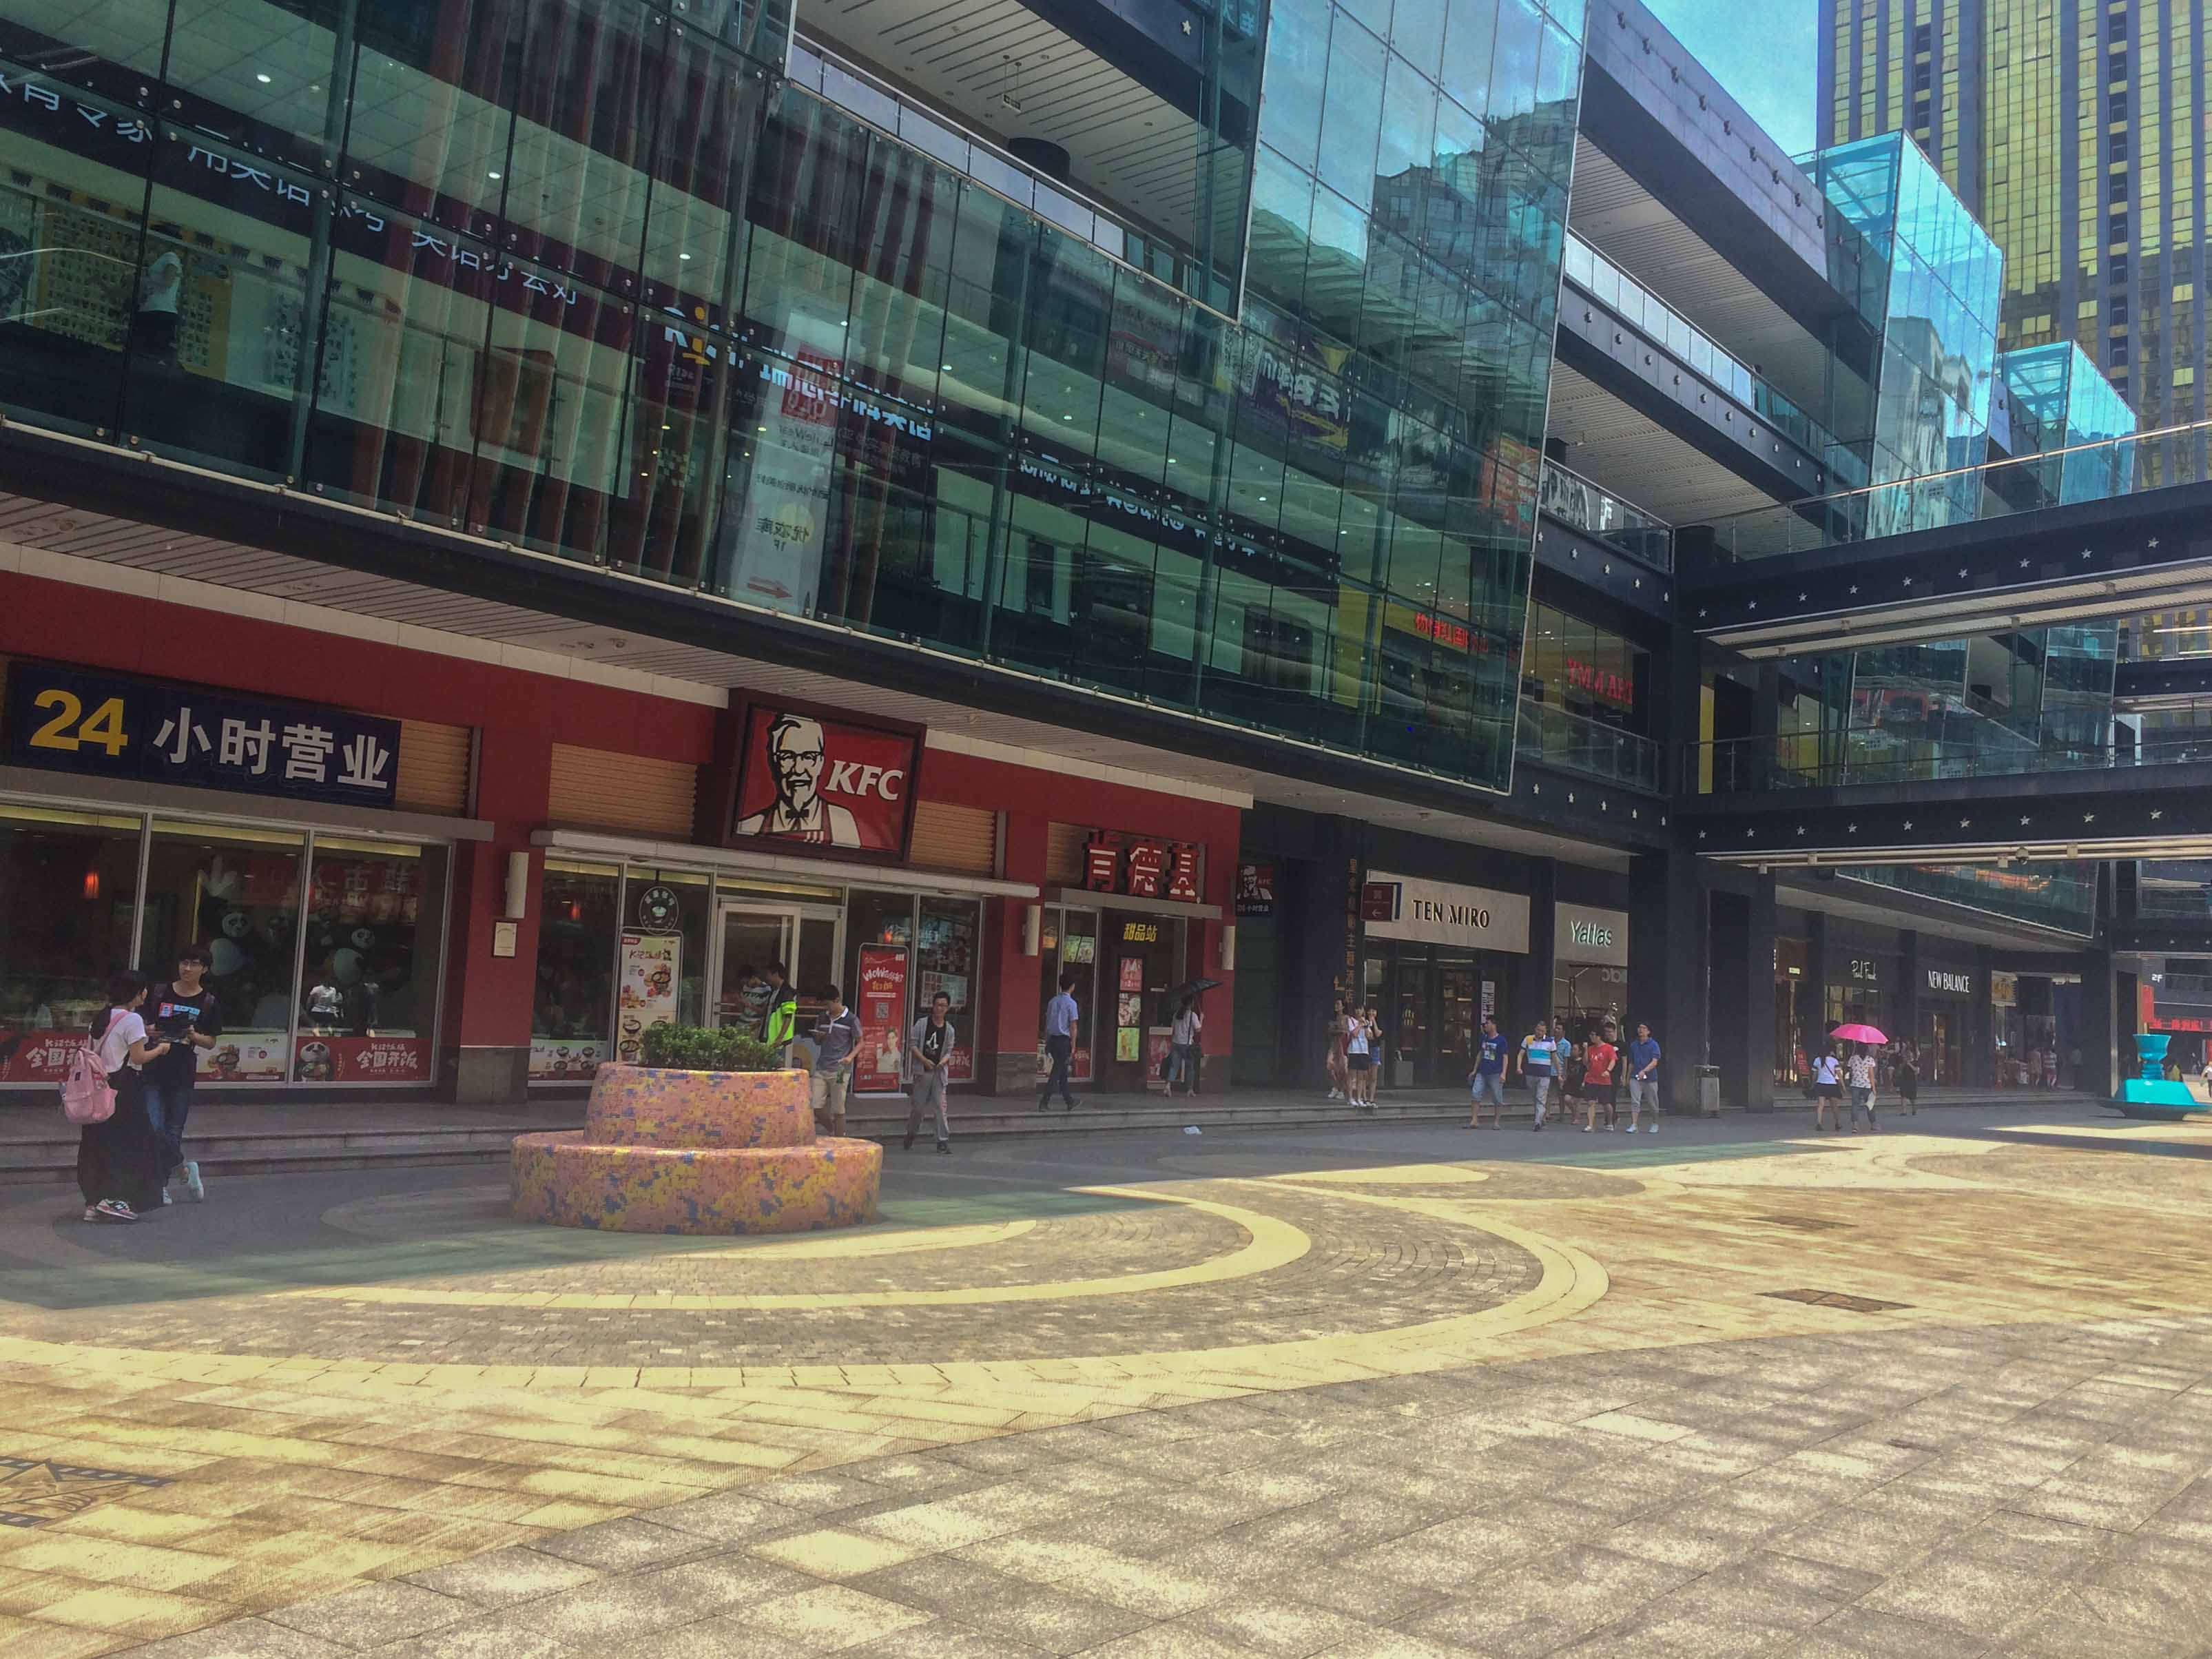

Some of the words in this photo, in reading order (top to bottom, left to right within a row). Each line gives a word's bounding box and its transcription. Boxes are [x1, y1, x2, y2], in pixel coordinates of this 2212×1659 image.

[29, 689, 128, 756] 24
[152, 708, 391, 789] 小时营业
[825, 759, 905, 801] KFC
[1084, 831, 1201, 903] 肯德基
[1413, 898, 1443, 923] TEN
[1448, 904, 1490, 929] MIRO
[1124, 922, 1158, 942] 甜品站
[1928, 970, 1943, 989] NEW
[1943, 972, 1970, 993] BALANCE
[2151, 973, 2164, 983] 2F
[356, 1050, 418, 1070] 全国开饭
